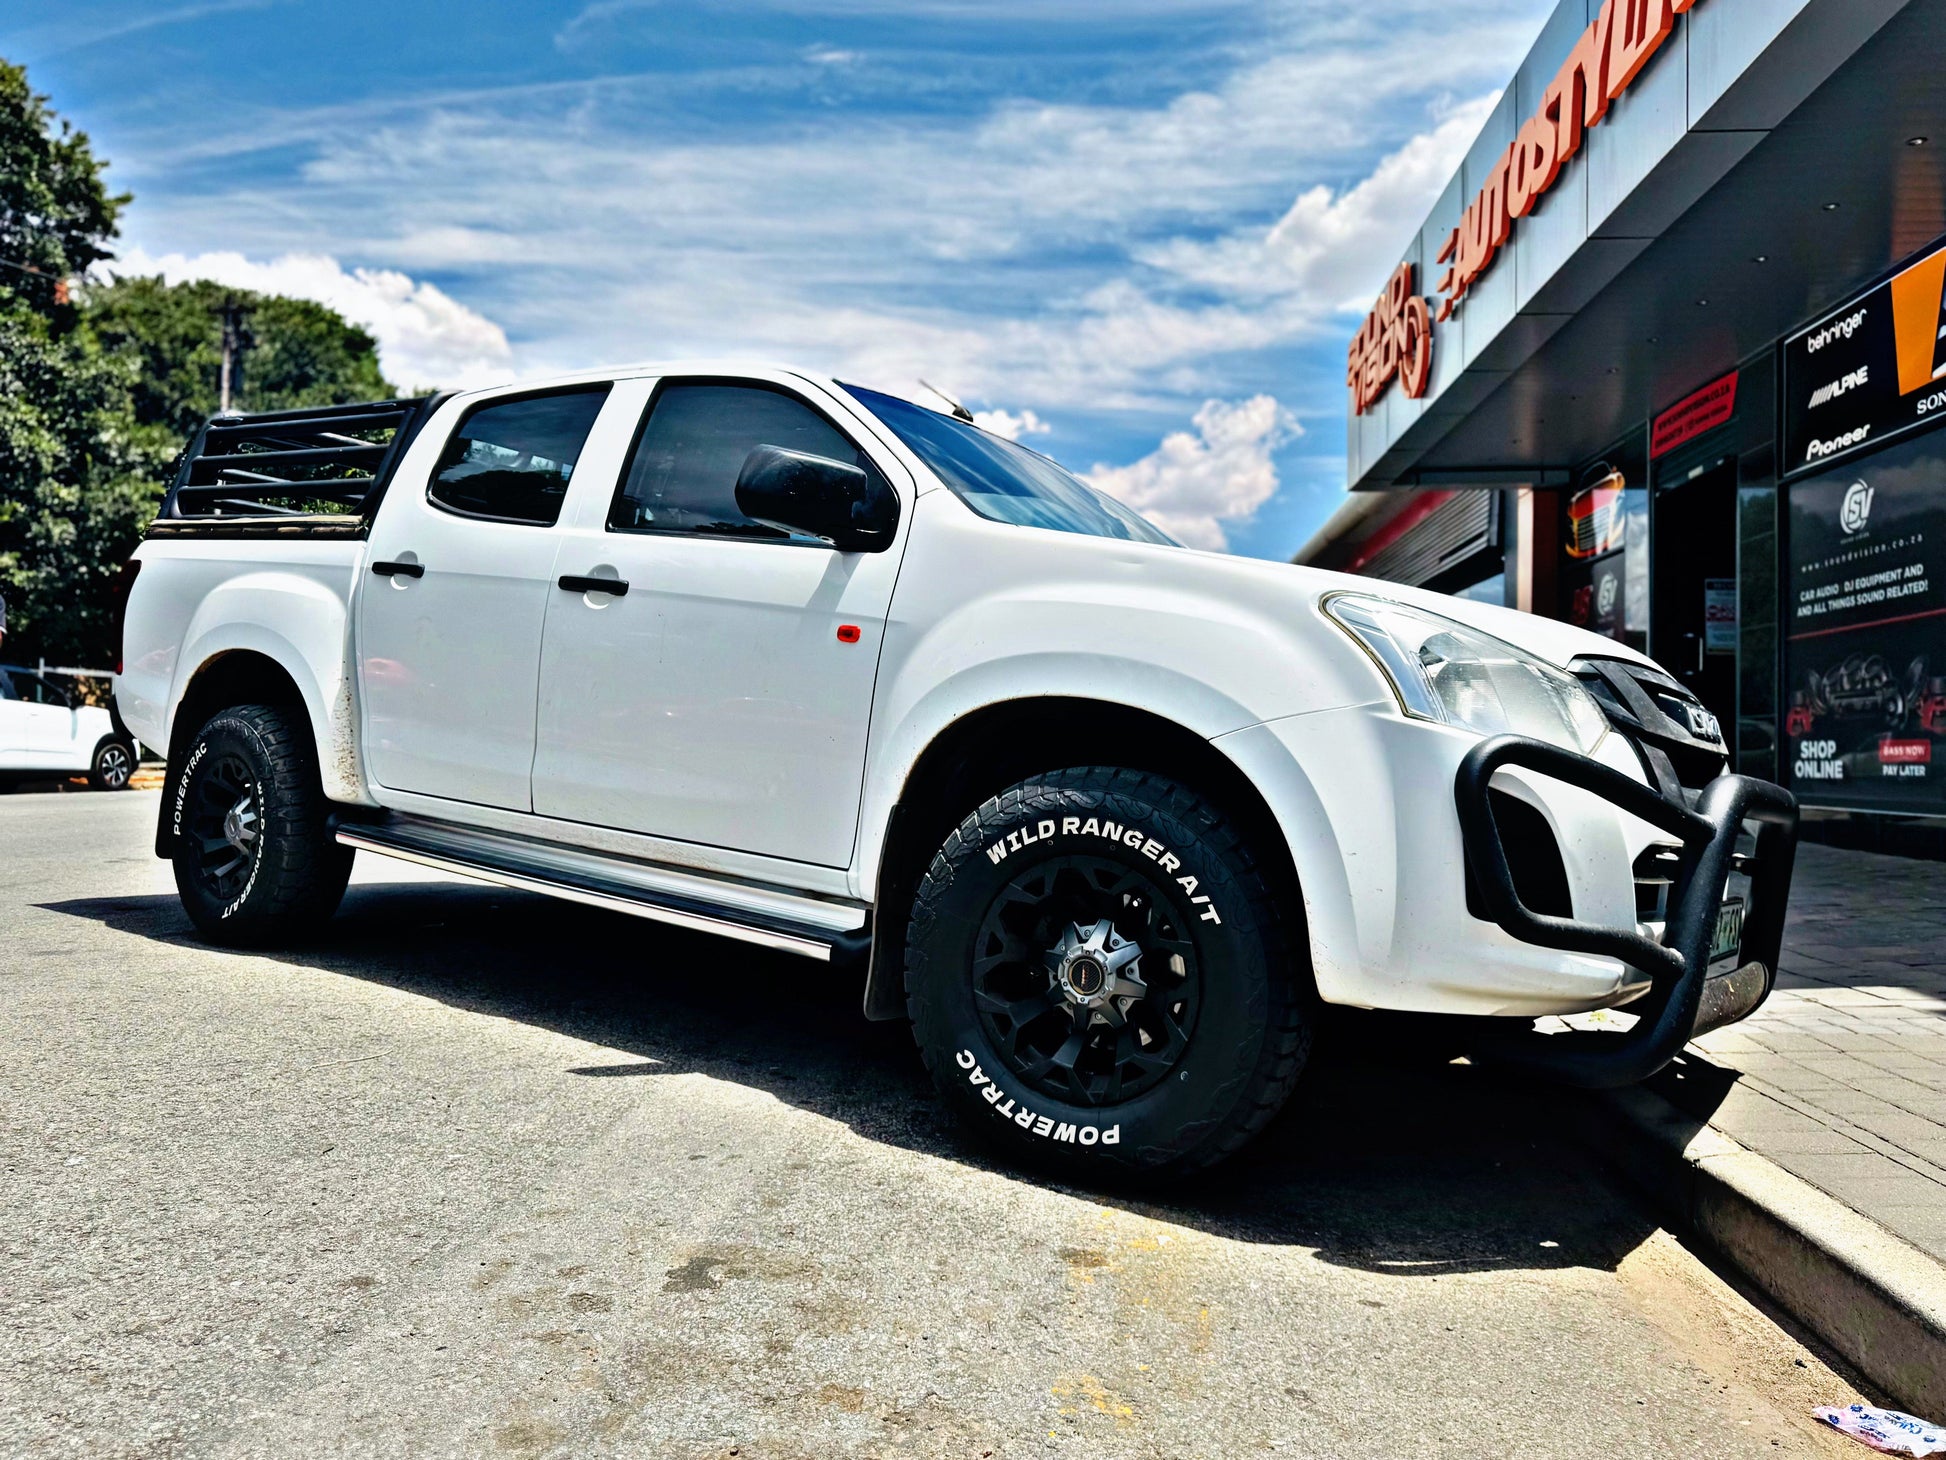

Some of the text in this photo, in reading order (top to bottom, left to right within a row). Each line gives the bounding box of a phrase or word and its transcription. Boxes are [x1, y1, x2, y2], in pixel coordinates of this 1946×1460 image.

[1450, 0, 1696, 304] AUTOSTYL
[1808, 308, 1868, 353] behringer
[1354, 302, 1409, 416] VISION
[1820, 365, 1868, 404] ALPINE
[1806, 423, 1871, 461] Pioneer
[1797, 579, 1929, 617] AND ALL THINGS SOUND RELATED!
[1800, 563, 1924, 602] CAR AUDIO DJ EQUIPMENT AND
[1800, 739, 1837, 759] SHOP
[1883, 745, 1925, 756] BASS NOW
[173, 742, 208, 836] POWERTRAC
[1794, 760, 1843, 779] ONLINE
[1882, 765, 1926, 776] PAY LATER
[986, 816, 1222, 925] WILD RANGER A/T
[955, 1048, 1120, 1145] POWERTRAC
